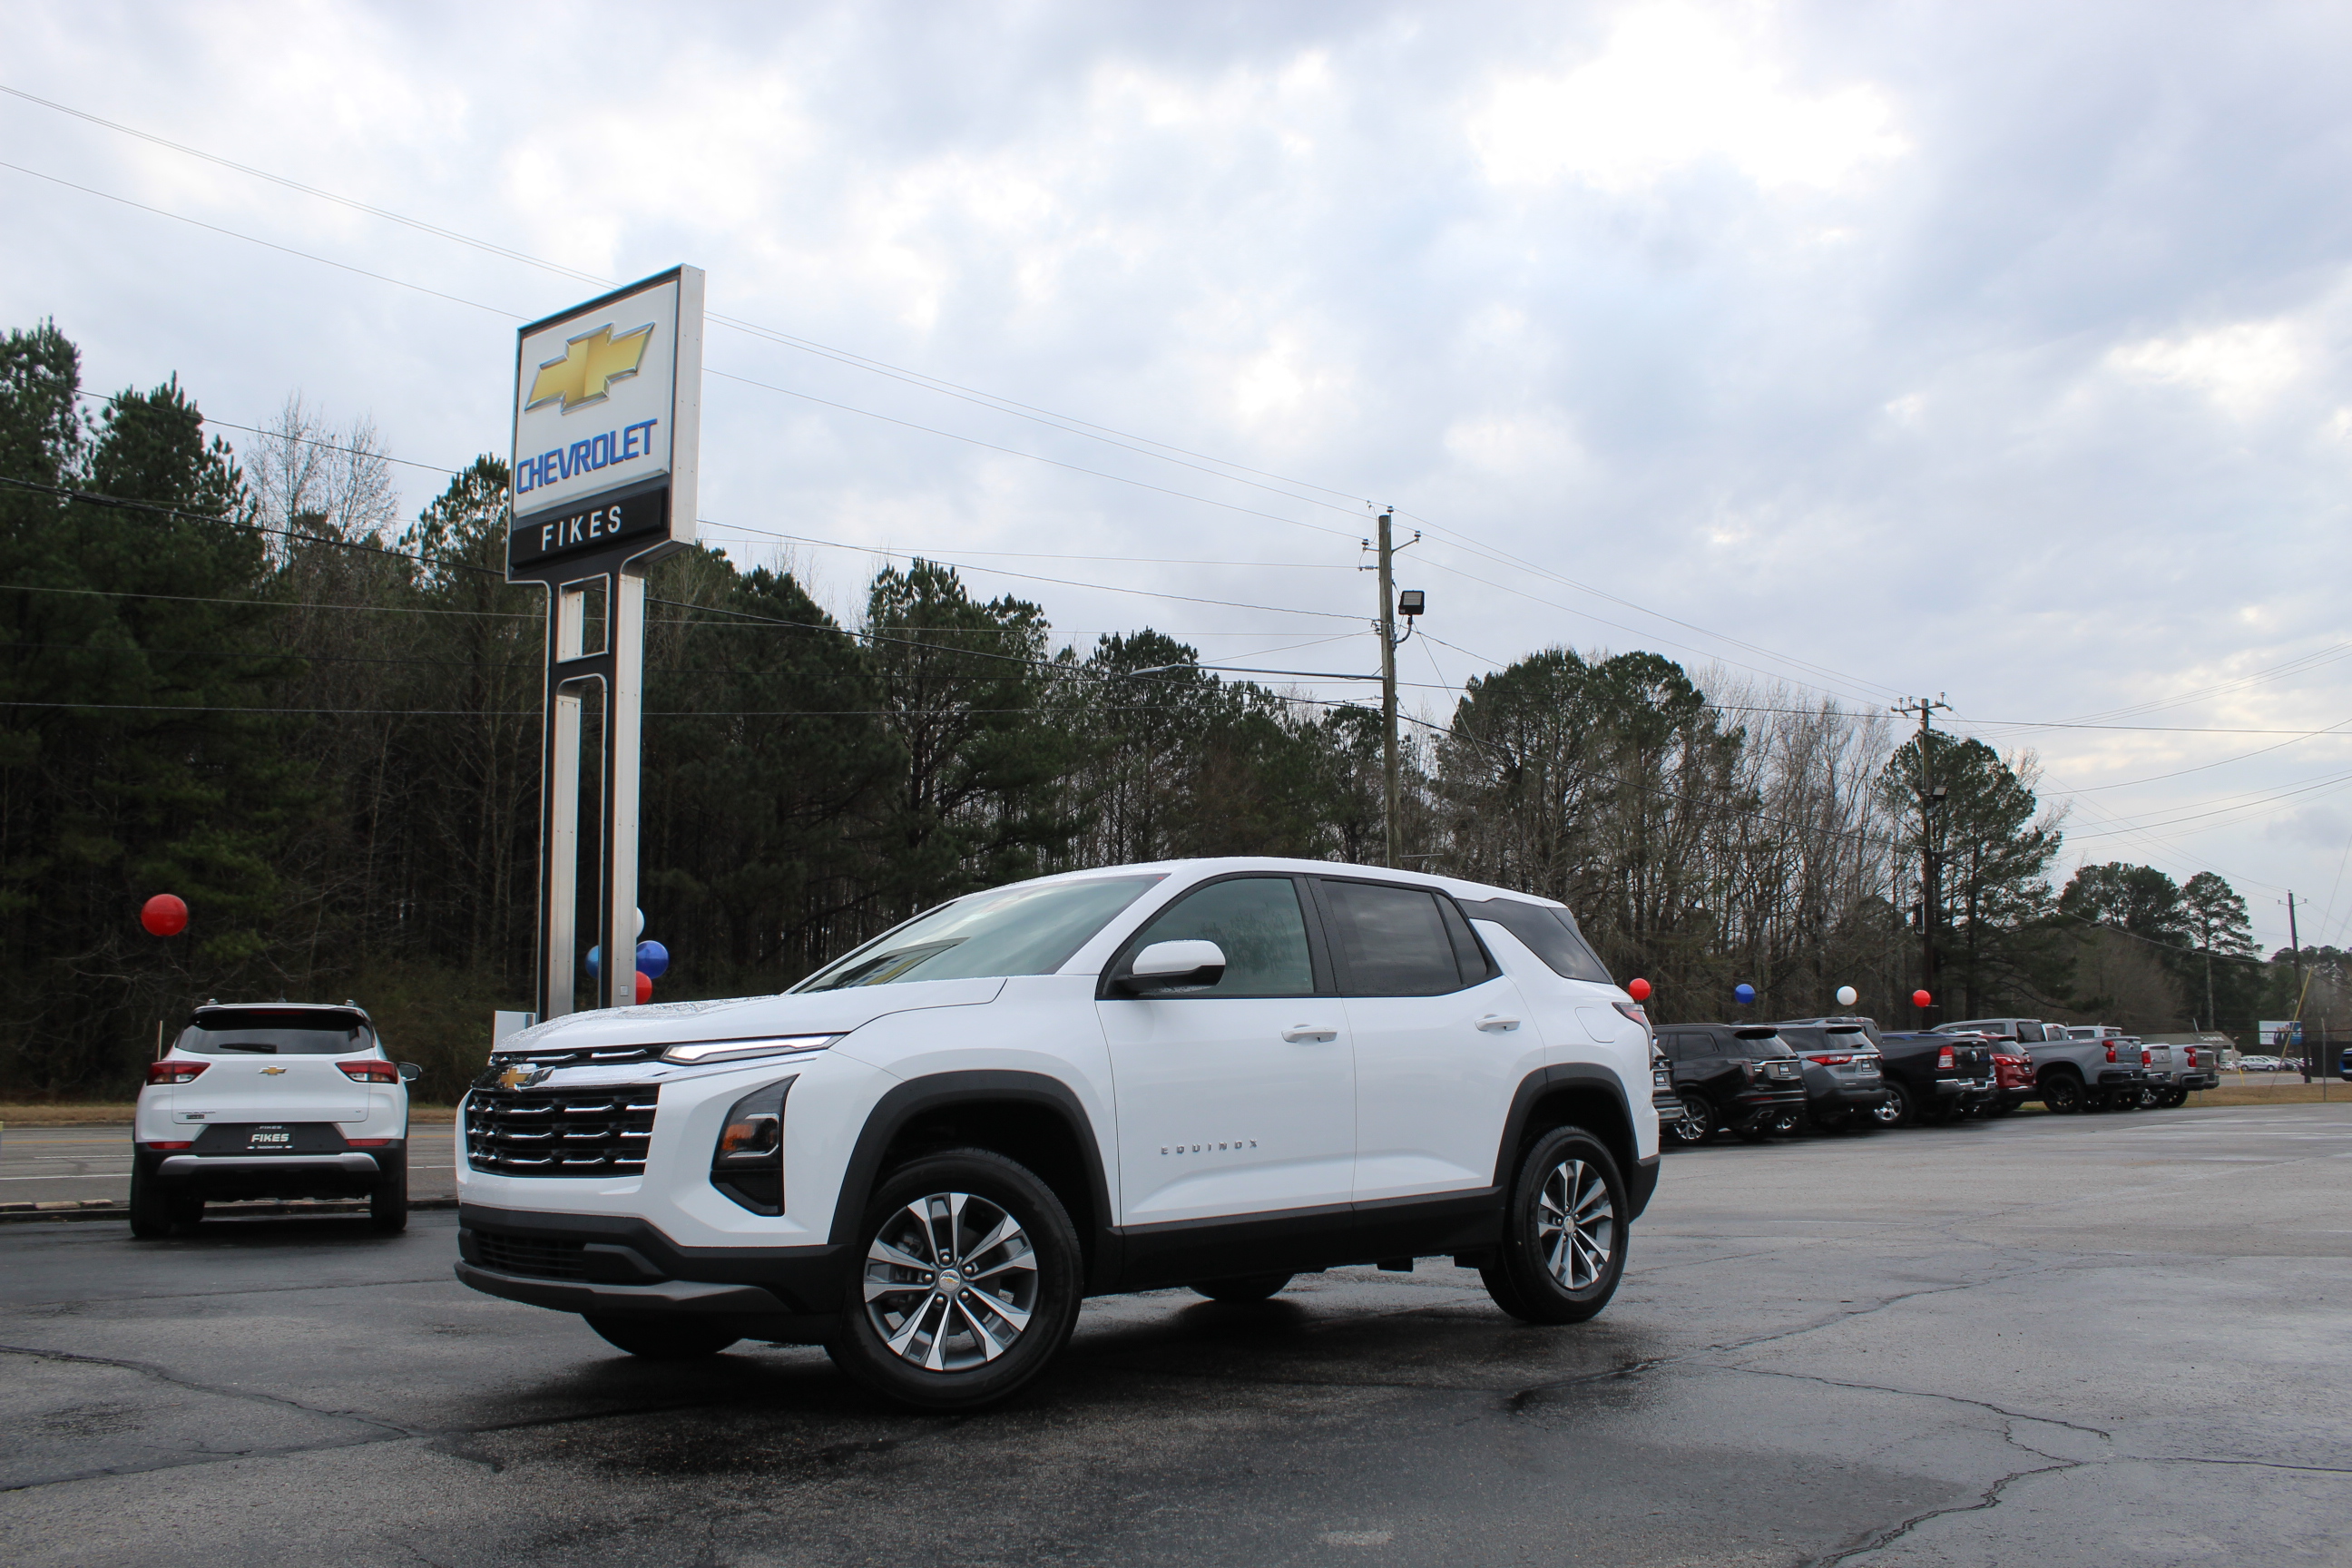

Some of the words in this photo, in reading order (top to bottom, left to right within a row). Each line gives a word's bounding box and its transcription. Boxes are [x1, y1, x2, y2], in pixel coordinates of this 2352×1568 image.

[515, 418, 658, 495] CHEVROLET
[541, 505, 622, 551] FIKES
[250, 1133, 289, 1142] FIKES
[1161, 1138, 1258, 1155] EQUINOX
